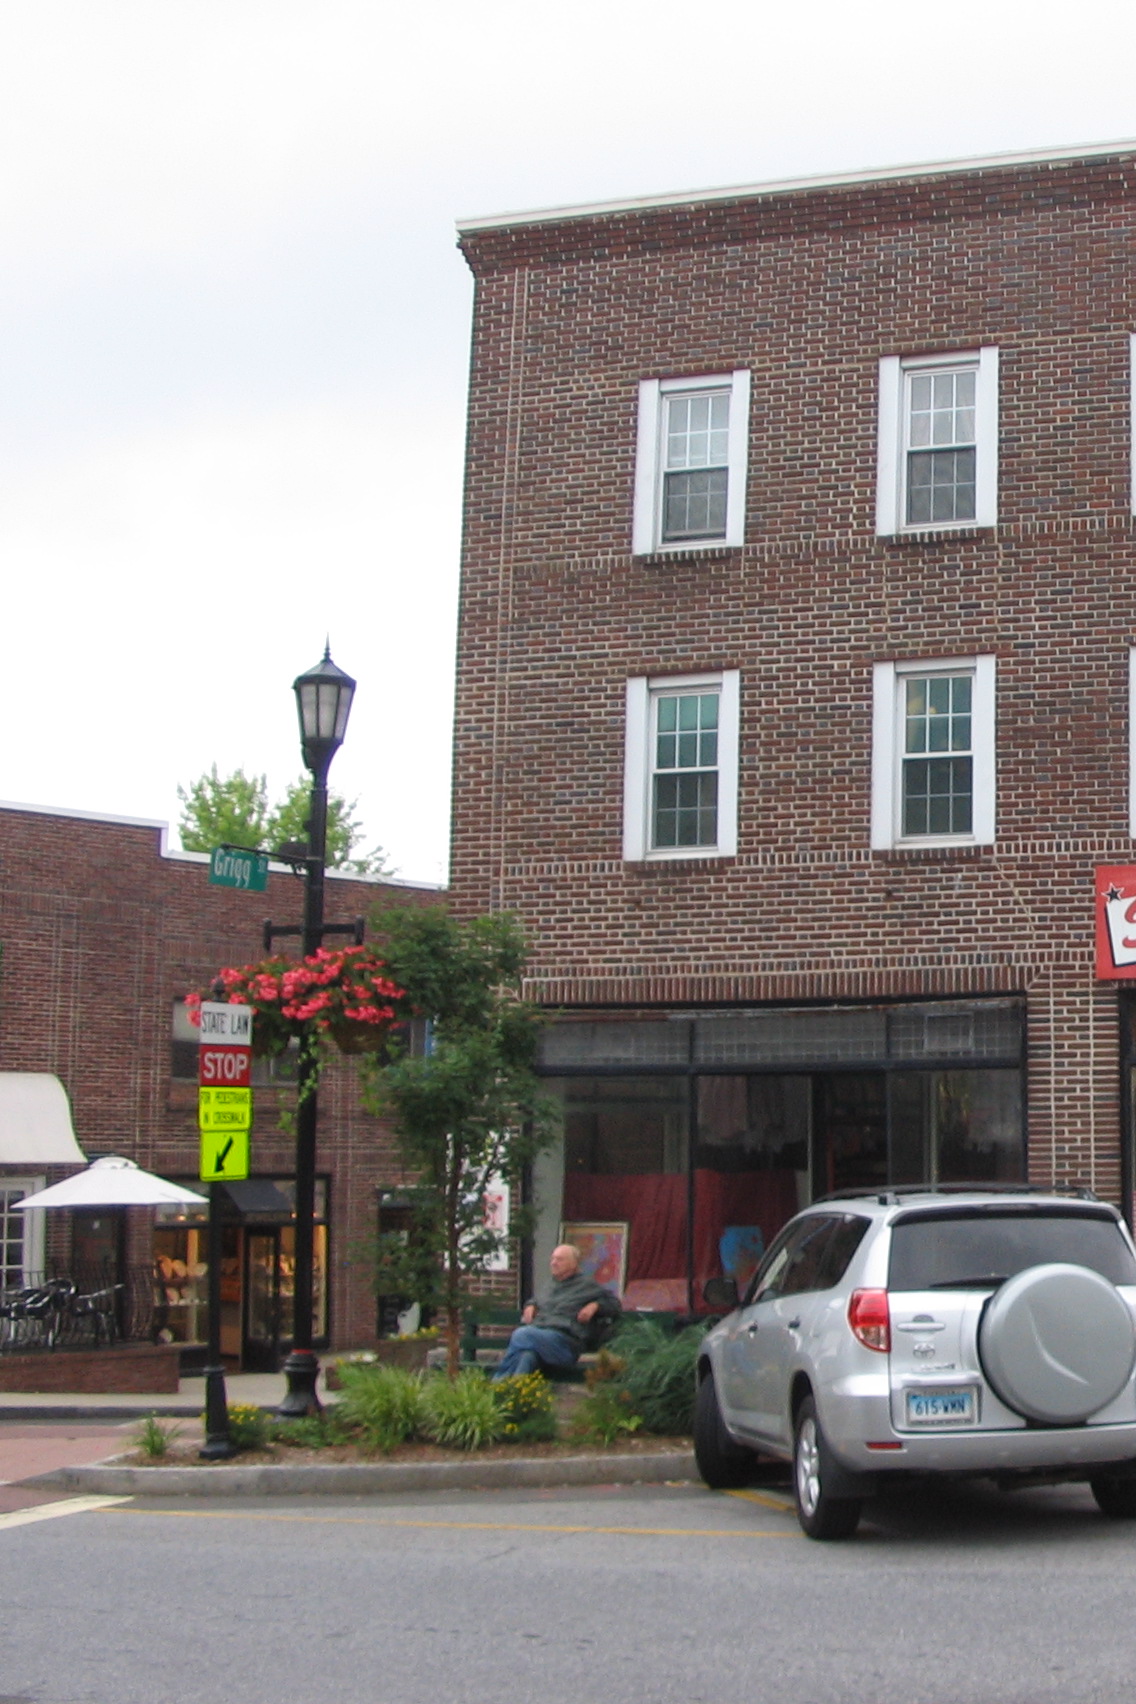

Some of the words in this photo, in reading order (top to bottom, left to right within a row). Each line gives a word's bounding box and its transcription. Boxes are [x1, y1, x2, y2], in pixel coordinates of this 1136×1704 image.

[214, 847, 252, 889] Grigg
[202, 1011, 226, 1034] STATE
[231, 1013, 249, 1035] LAW
[203, 1052, 248, 1079] STOP
[213, 1112, 245, 1124] CROSSWALK
